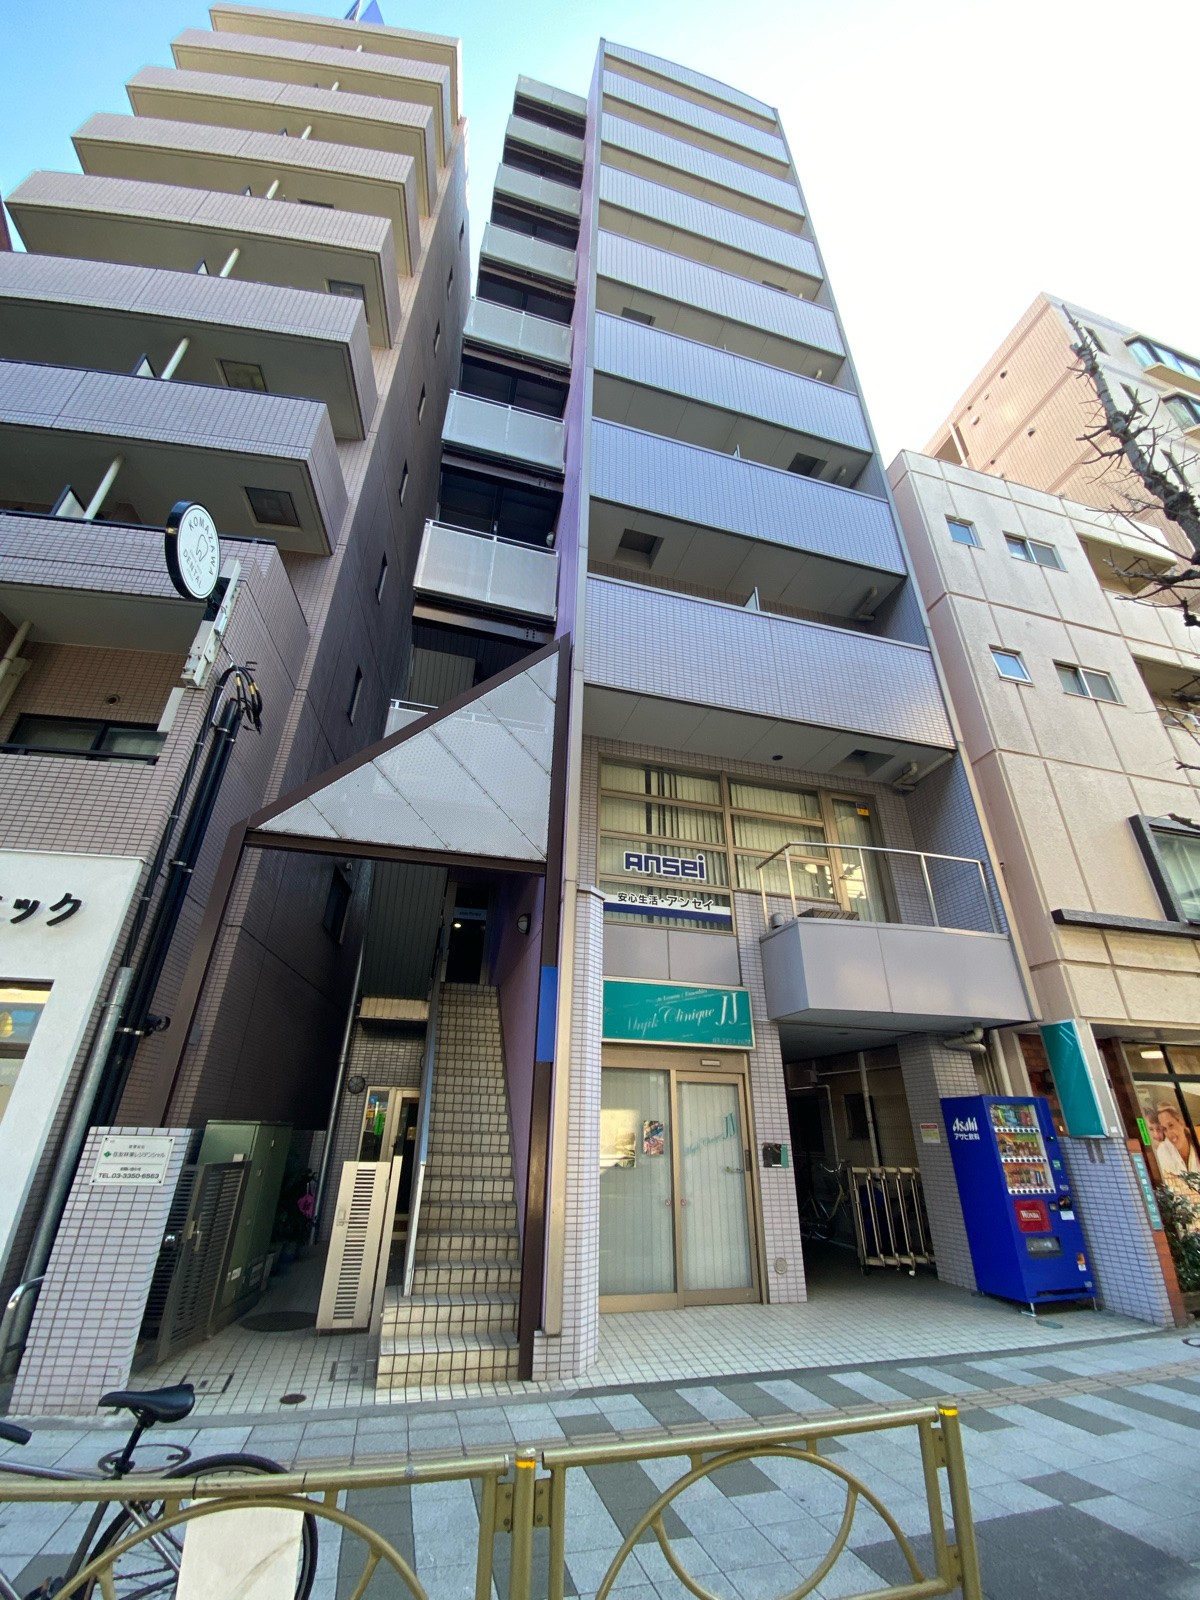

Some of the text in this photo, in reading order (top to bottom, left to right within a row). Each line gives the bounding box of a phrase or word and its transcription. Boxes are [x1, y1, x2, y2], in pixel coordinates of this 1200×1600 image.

[188, 516, 216, 576] KOMAZAWA
[183, 549, 202, 588] DENTAL
[0, 893, 82, 927] ック
[617, 892, 713, 911] 安心生活・アンセイ
[658, 1005, 715, 1026] Clinique
[715, 991, 738, 1026] JJ
[952, 1117, 978, 1132] Asahi
[953, 1132, 980, 1141] アサヒ飲料
